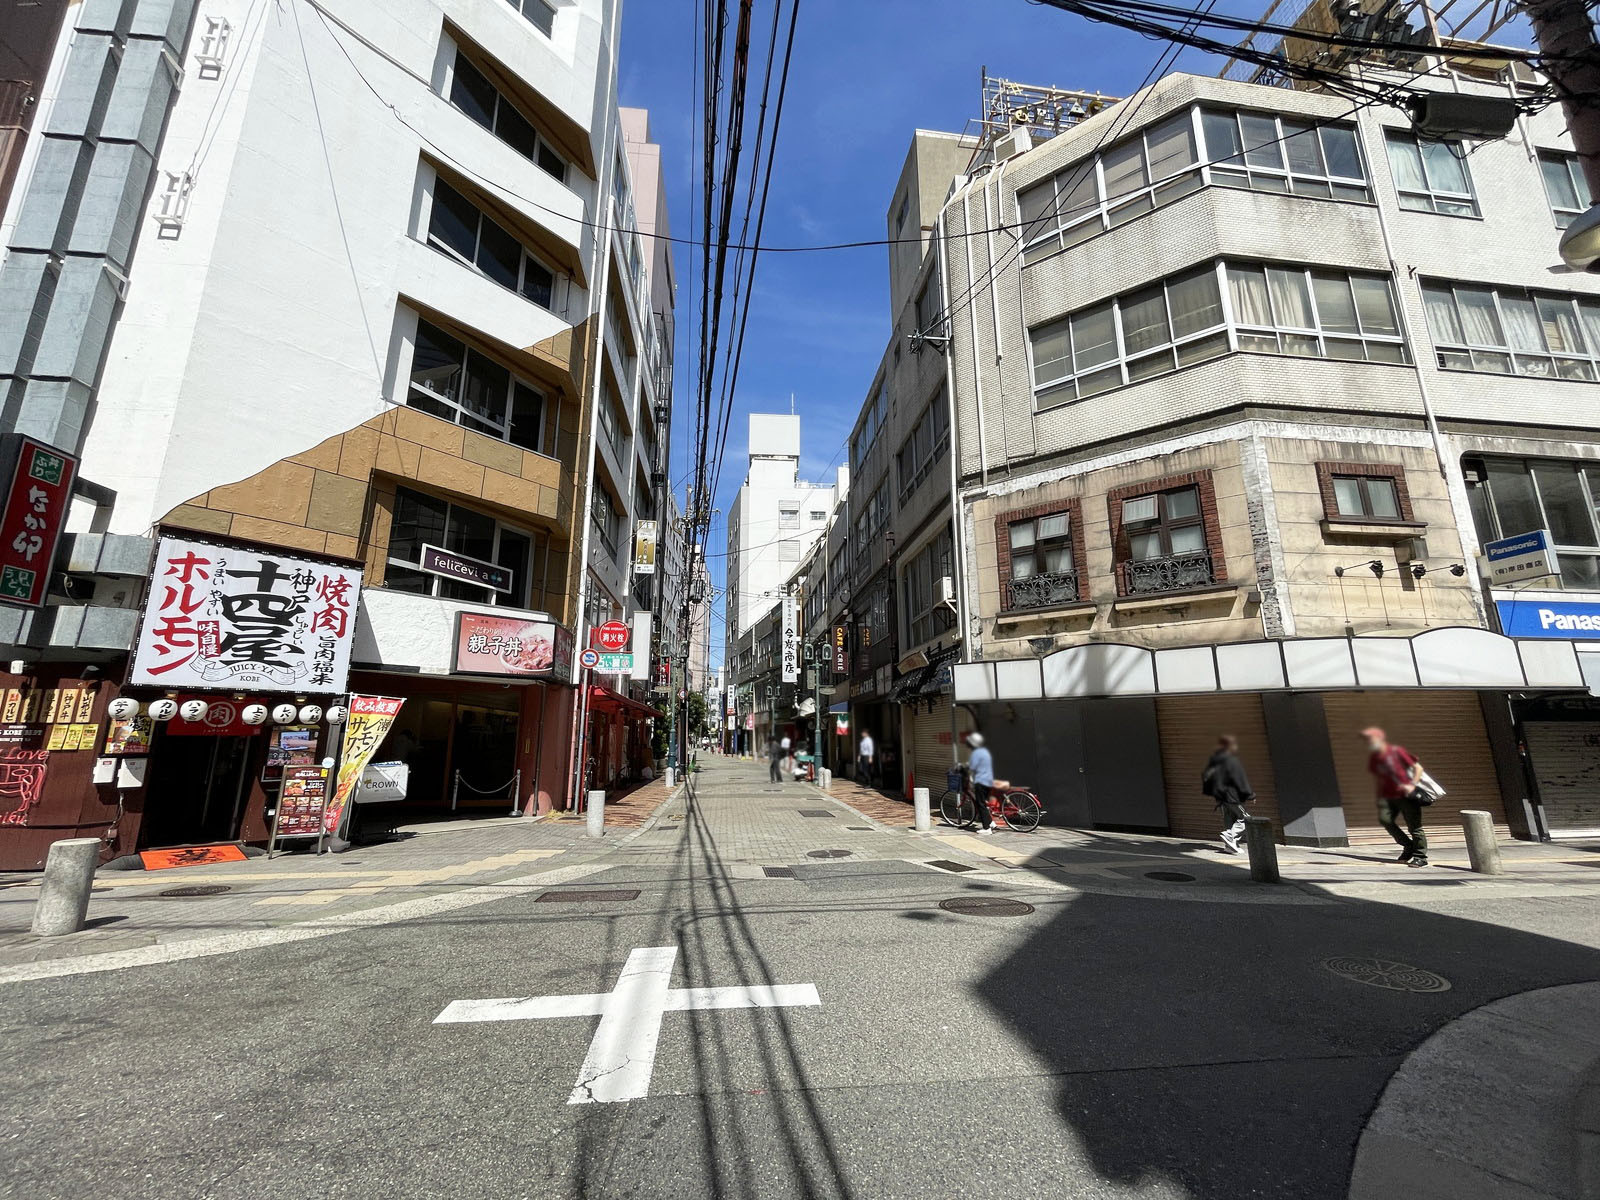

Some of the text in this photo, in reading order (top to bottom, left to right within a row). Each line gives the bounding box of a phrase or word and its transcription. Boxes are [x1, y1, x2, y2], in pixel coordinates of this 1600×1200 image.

[1490, 540, 1539, 556] Panasonic
[206, 558, 227, 616] うまい やすい
[289, 567, 317, 612] 神戸
[146, 551, 212, 676] ホルモン
[310, 573, 353, 638] 焼肉
[467, 633, 523, 658] 親子丼
[602, 632, 625, 643] 消火栓
[229, 662, 275, 677] JUICY-YA
[308, 635, 337, 686] 旨肉福来
[158, 701, 175, 720] カルビ
[210, 705, 230, 723] 肉
[353, 701, 400, 714] 飲み放題
[365, 780, 400, 790] CROWN
